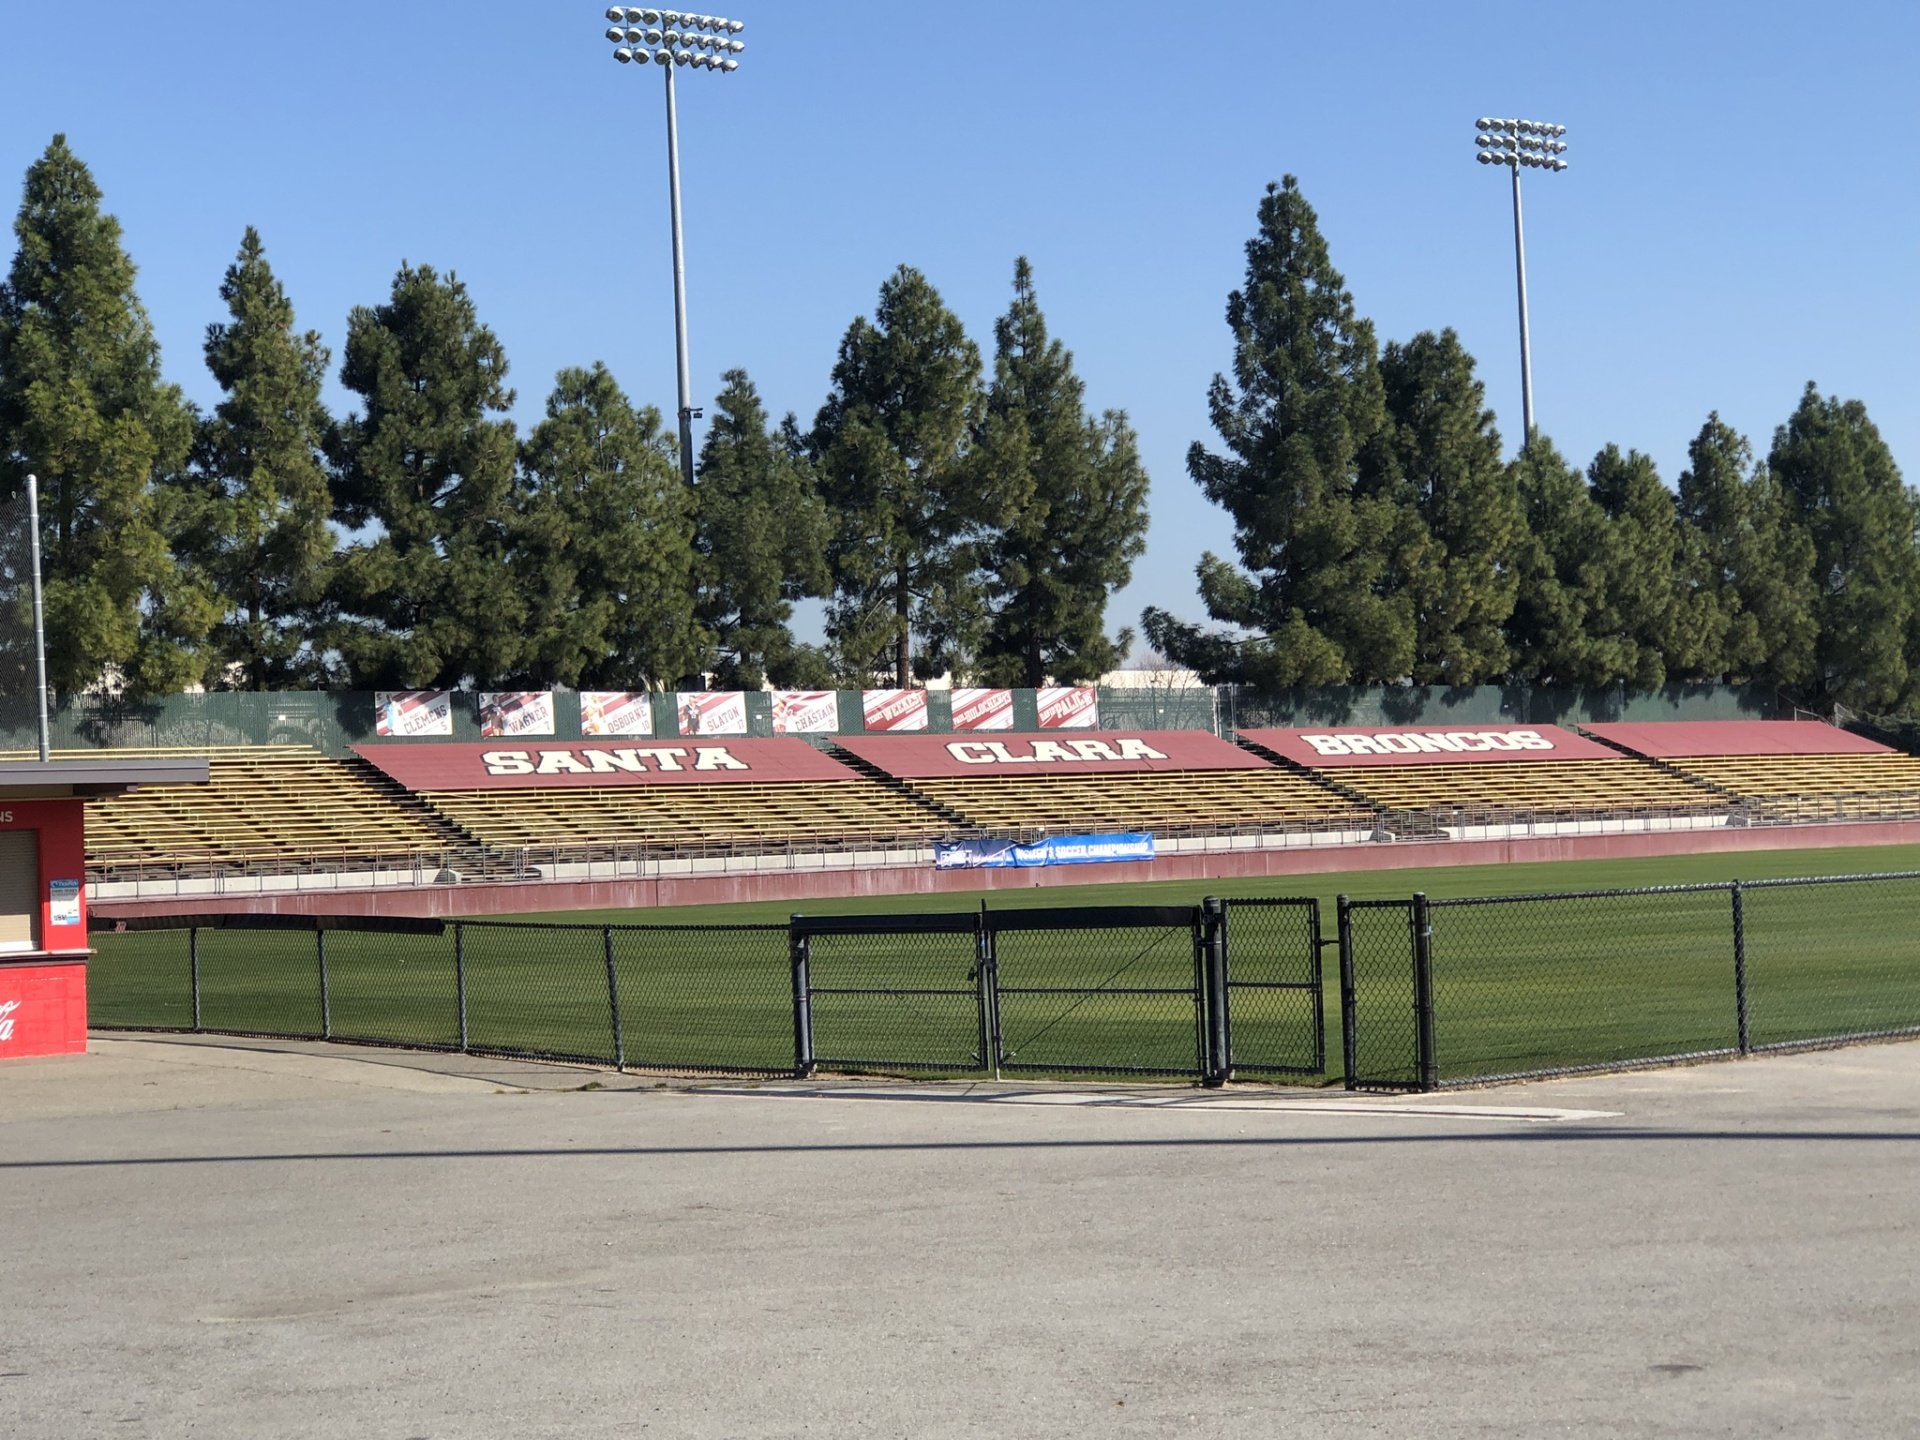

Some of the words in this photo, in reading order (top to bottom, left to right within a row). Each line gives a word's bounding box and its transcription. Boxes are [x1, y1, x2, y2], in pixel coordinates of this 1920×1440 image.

[795, 702, 835, 731] CHASTAIN
[881, 692, 921, 721] WEEKES
[1053, 690, 1084, 719] PALIC
[404, 704, 447, 734] CLEMENS
[509, 706, 549, 733] WAGNER
[544, 720, 550, 730] 7
[607, 705, 647, 733] OSBORNE
[642, 720, 650, 731] 10
[707, 706, 740, 731] SLATON
[737, 719, 744, 730] 17
[479, 747, 752, 776] SANTA
[944, 738, 1171, 764] CLARA
[1298, 730, 1556, 755] BRONCOS
[1055, 844, 1087, 859] SOCCER
[1088, 842, 1149, 857] CHAMPIONSHIP
